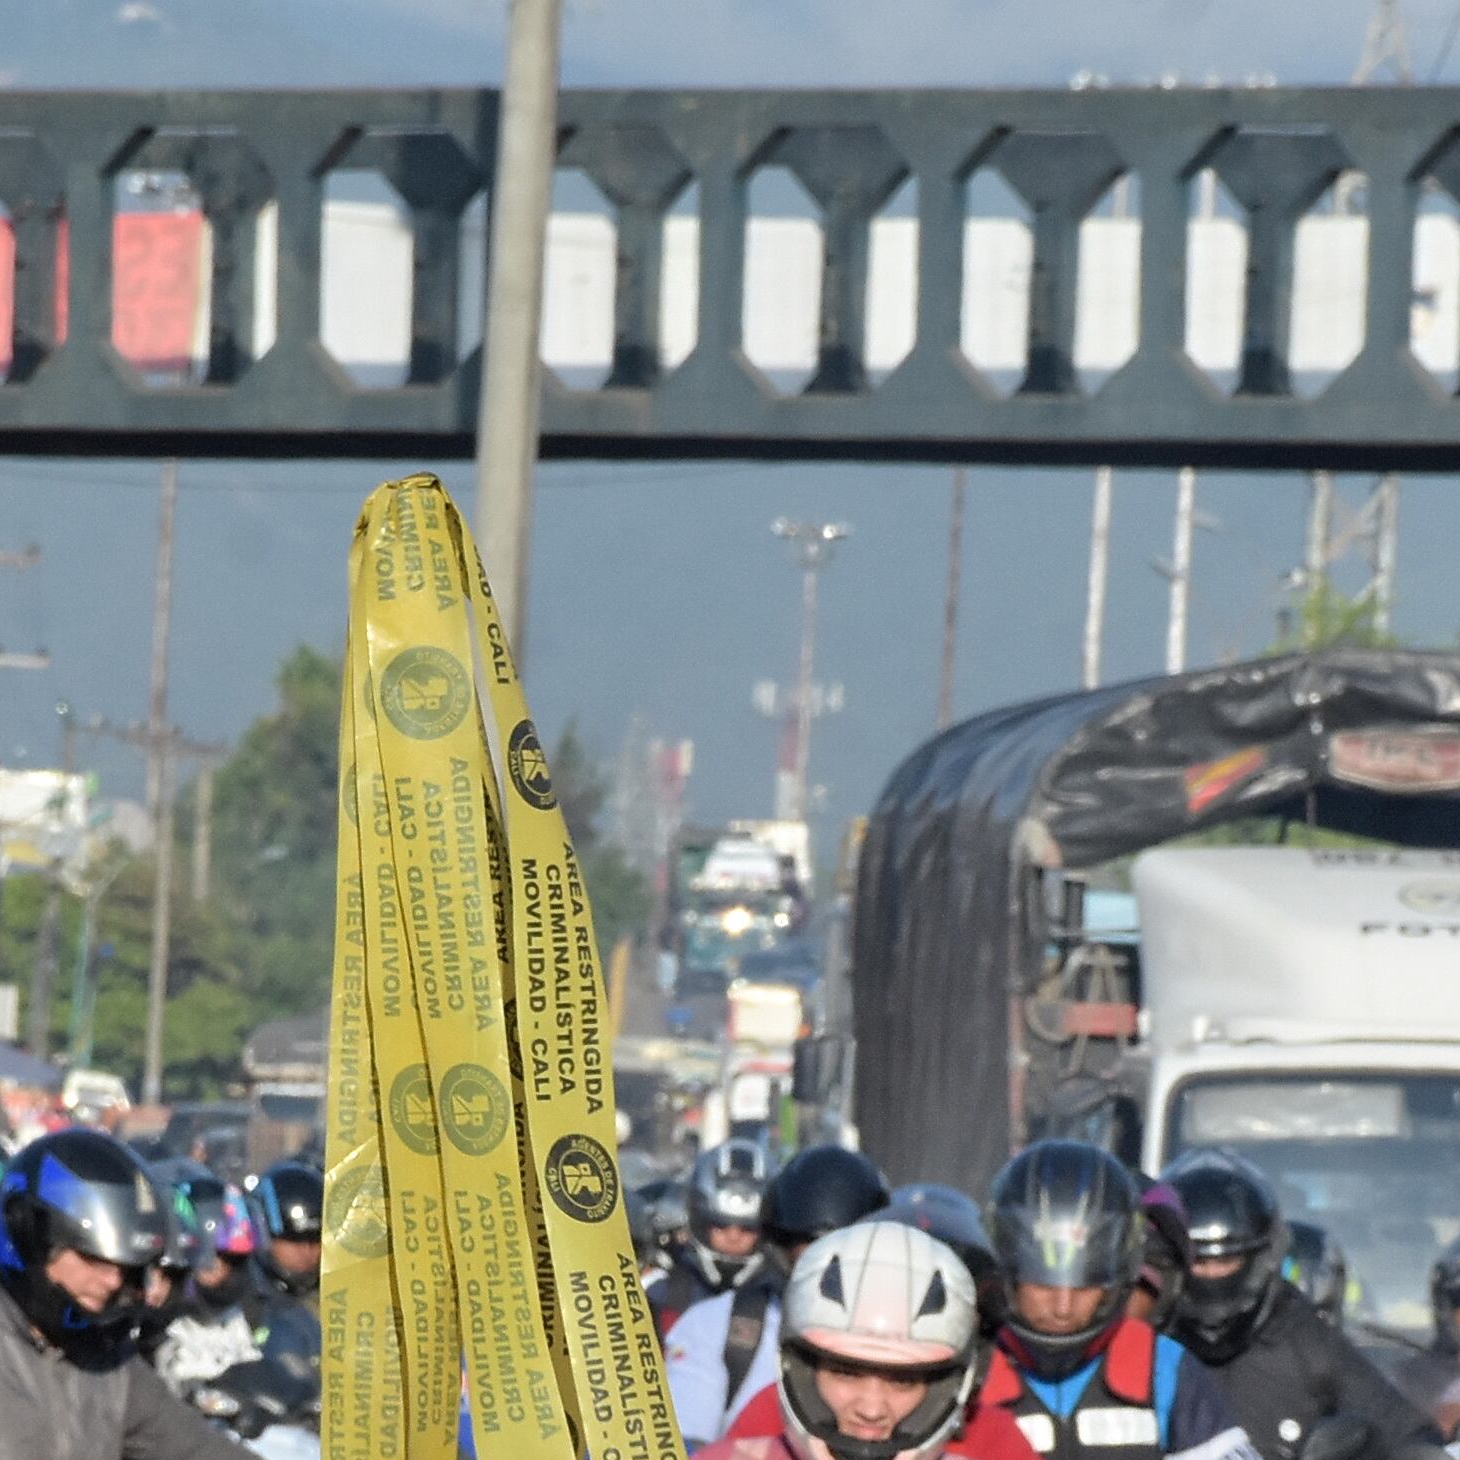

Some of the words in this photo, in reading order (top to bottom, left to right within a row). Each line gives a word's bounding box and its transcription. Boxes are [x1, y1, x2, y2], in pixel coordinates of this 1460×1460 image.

[487, 622, 510, 686] CALI
[521, 857, 547, 1012] MOVILIDAD
[544, 863, 577, 1095] CRIMINALÍSTICA
[531, 1038, 552, 1101] CALI
[573, 920, 605, 1115] RESTRINGIDA
[548, 1167, 561, 1192] CALI
[616, 1251, 645, 1325] ÁREA
[568, 1270, 614, 1422] MOVILIDAD
